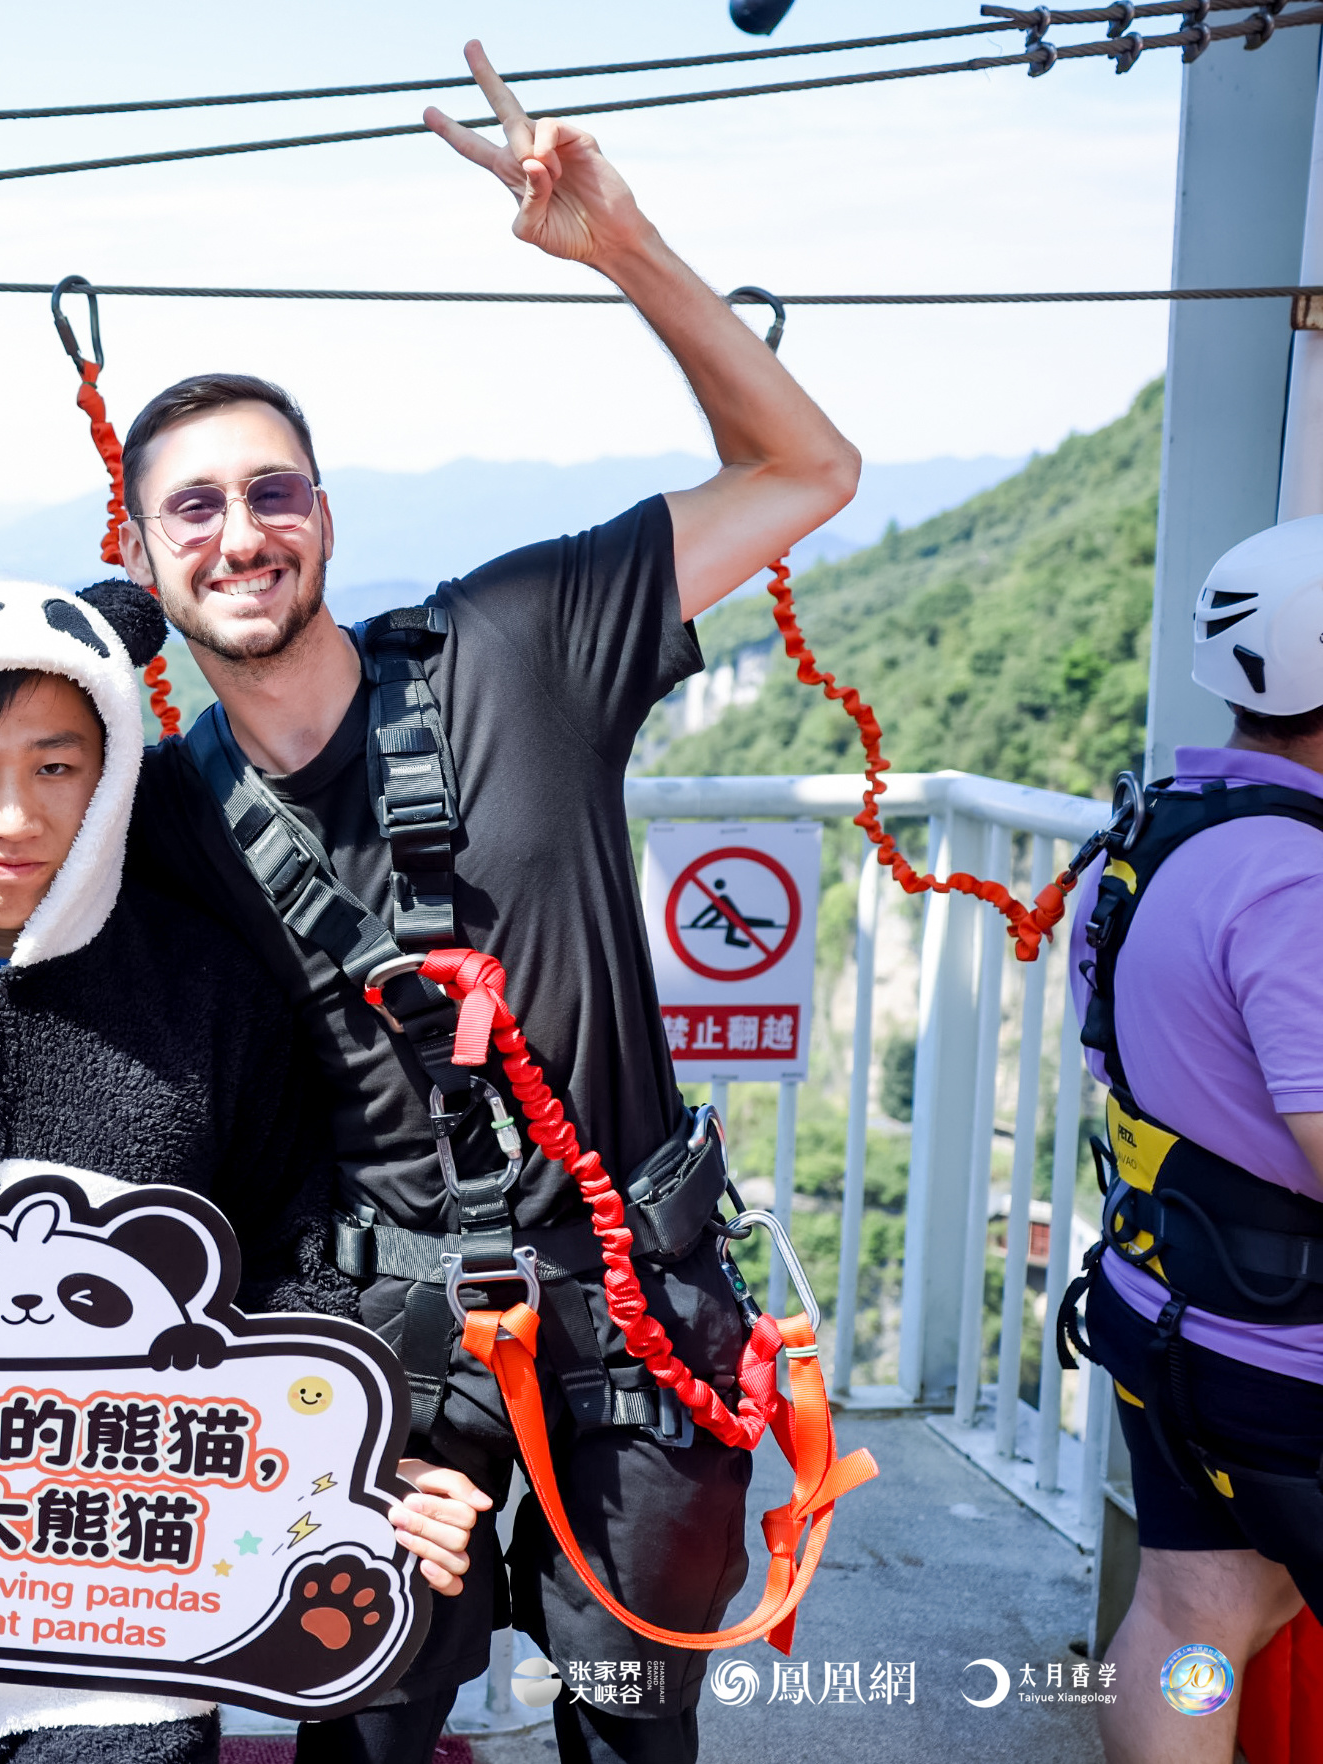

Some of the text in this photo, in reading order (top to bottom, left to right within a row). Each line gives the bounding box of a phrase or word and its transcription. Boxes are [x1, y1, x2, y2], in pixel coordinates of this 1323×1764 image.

[662, 1014, 795, 1051] 禁止翻越
[86, 1583, 221, 1614] pandas
[32, 1616, 167, 1648] pandas
